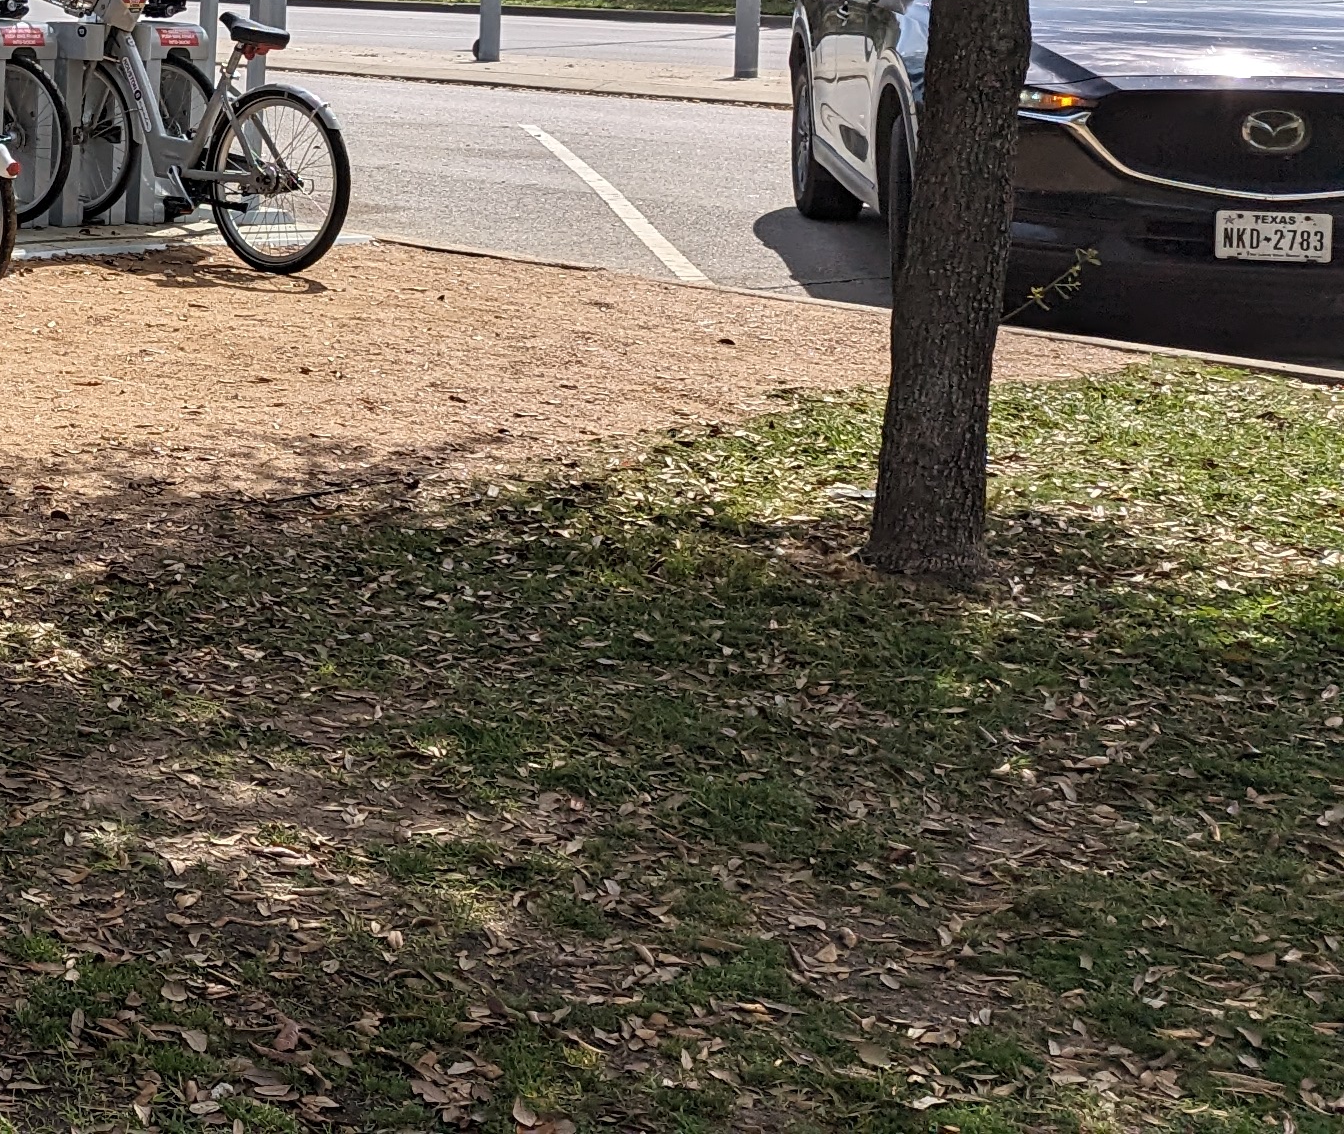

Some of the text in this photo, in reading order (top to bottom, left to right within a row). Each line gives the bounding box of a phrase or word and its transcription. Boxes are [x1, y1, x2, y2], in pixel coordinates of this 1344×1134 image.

[123, 58, 138, 91] HOUSTON
[1253, 215, 1297, 225] TEXAS
[1223, 227, 1324, 251] NKD 2783
